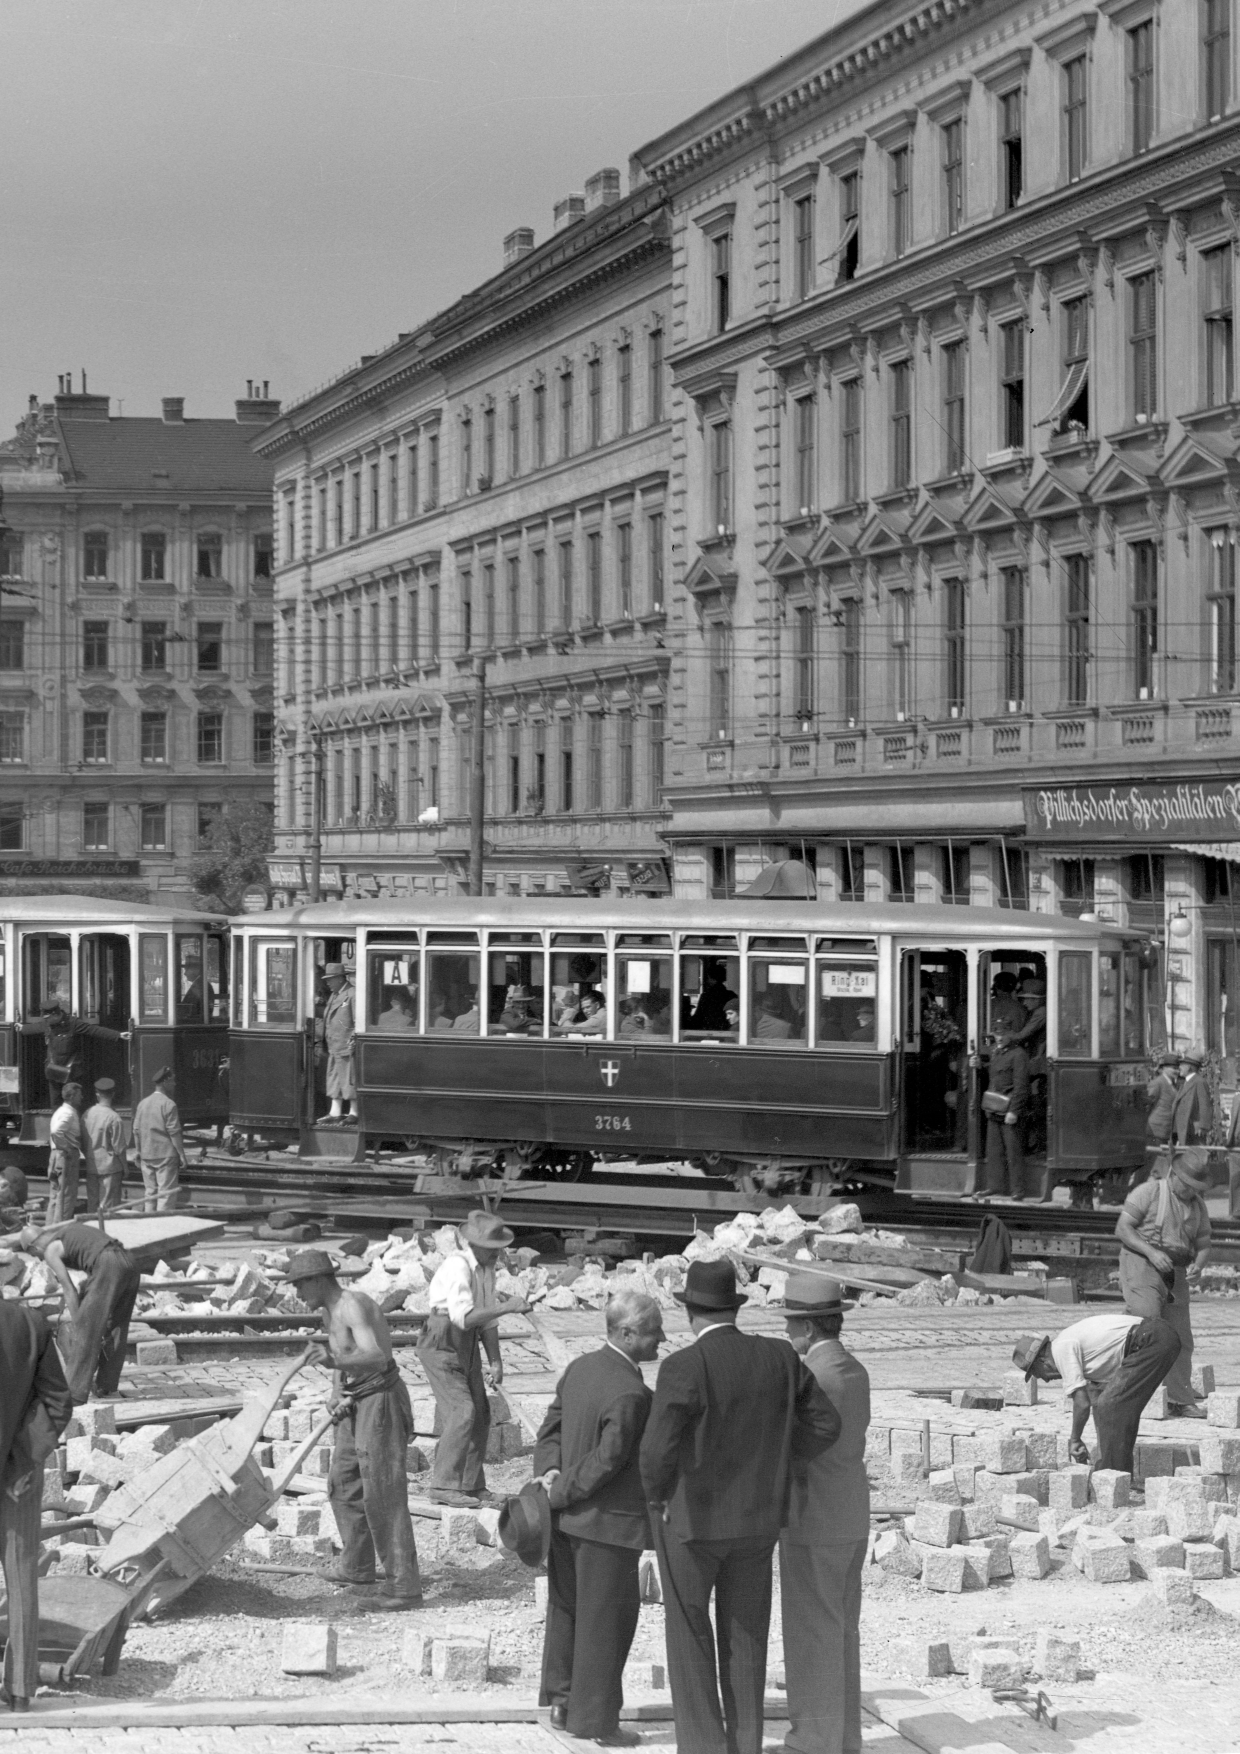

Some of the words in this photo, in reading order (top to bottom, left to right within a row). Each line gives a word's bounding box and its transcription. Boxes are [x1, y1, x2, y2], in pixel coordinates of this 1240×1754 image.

[34, 861, 130, 874] Reichsbrücke
[391, 961, 402, 983] A
[595, 1115, 632, 1131] 3764
